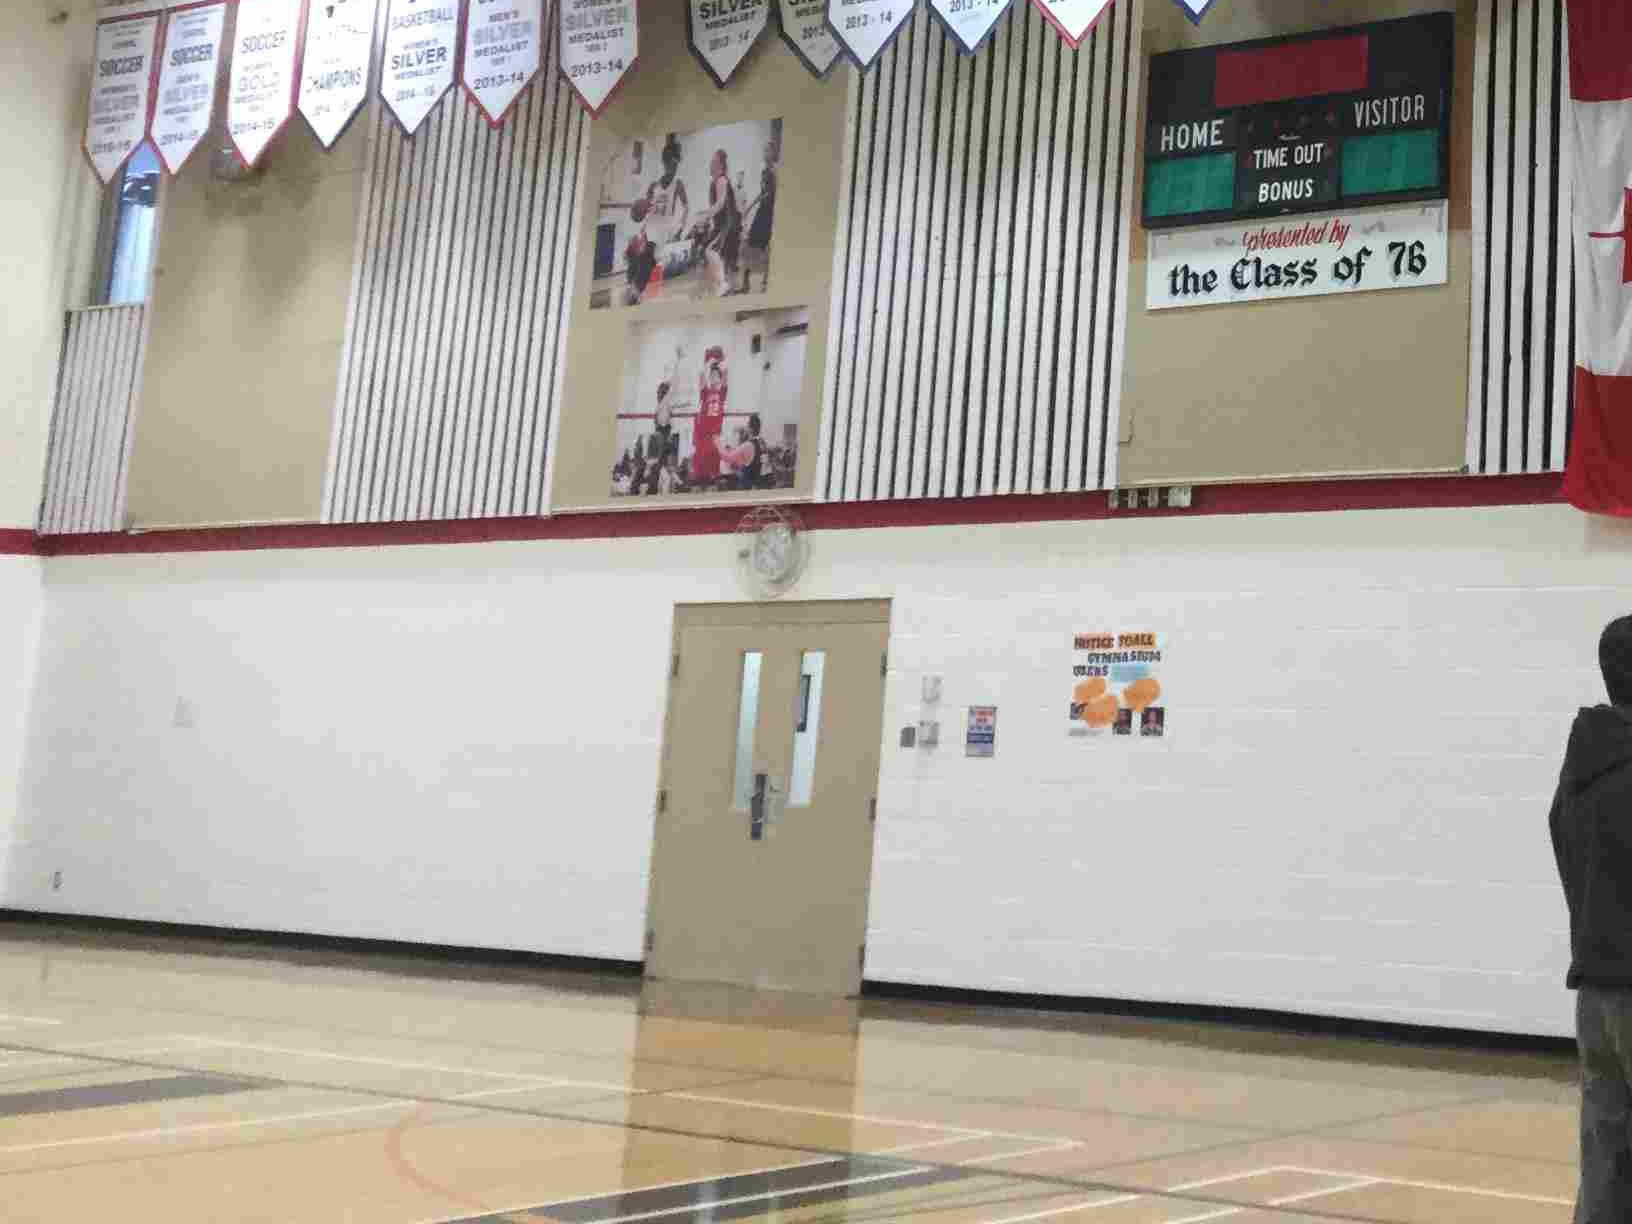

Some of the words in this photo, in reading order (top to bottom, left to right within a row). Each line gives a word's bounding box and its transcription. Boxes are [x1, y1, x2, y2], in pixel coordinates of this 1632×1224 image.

[568, 28, 624, 44] MEDALIST
[392, 47, 447, 69] SILVER
[571, 59, 623, 77] 2013-14
[1354, 94, 1425, 128] VISITOR
[1161, 119, 1224, 152] HOME
[1254, 147, 1288, 169] TIME
[1294, 144, 1324, 164] OUT
[1258, 179, 1313, 203] BONUS
[1329, 219, 1351, 247] by
[1168, 263, 1218, 297] the
[1231, 255, 1319, 290] Class
[1333, 246, 1371, 287] of
[1388, 240, 1426, 277] 76
